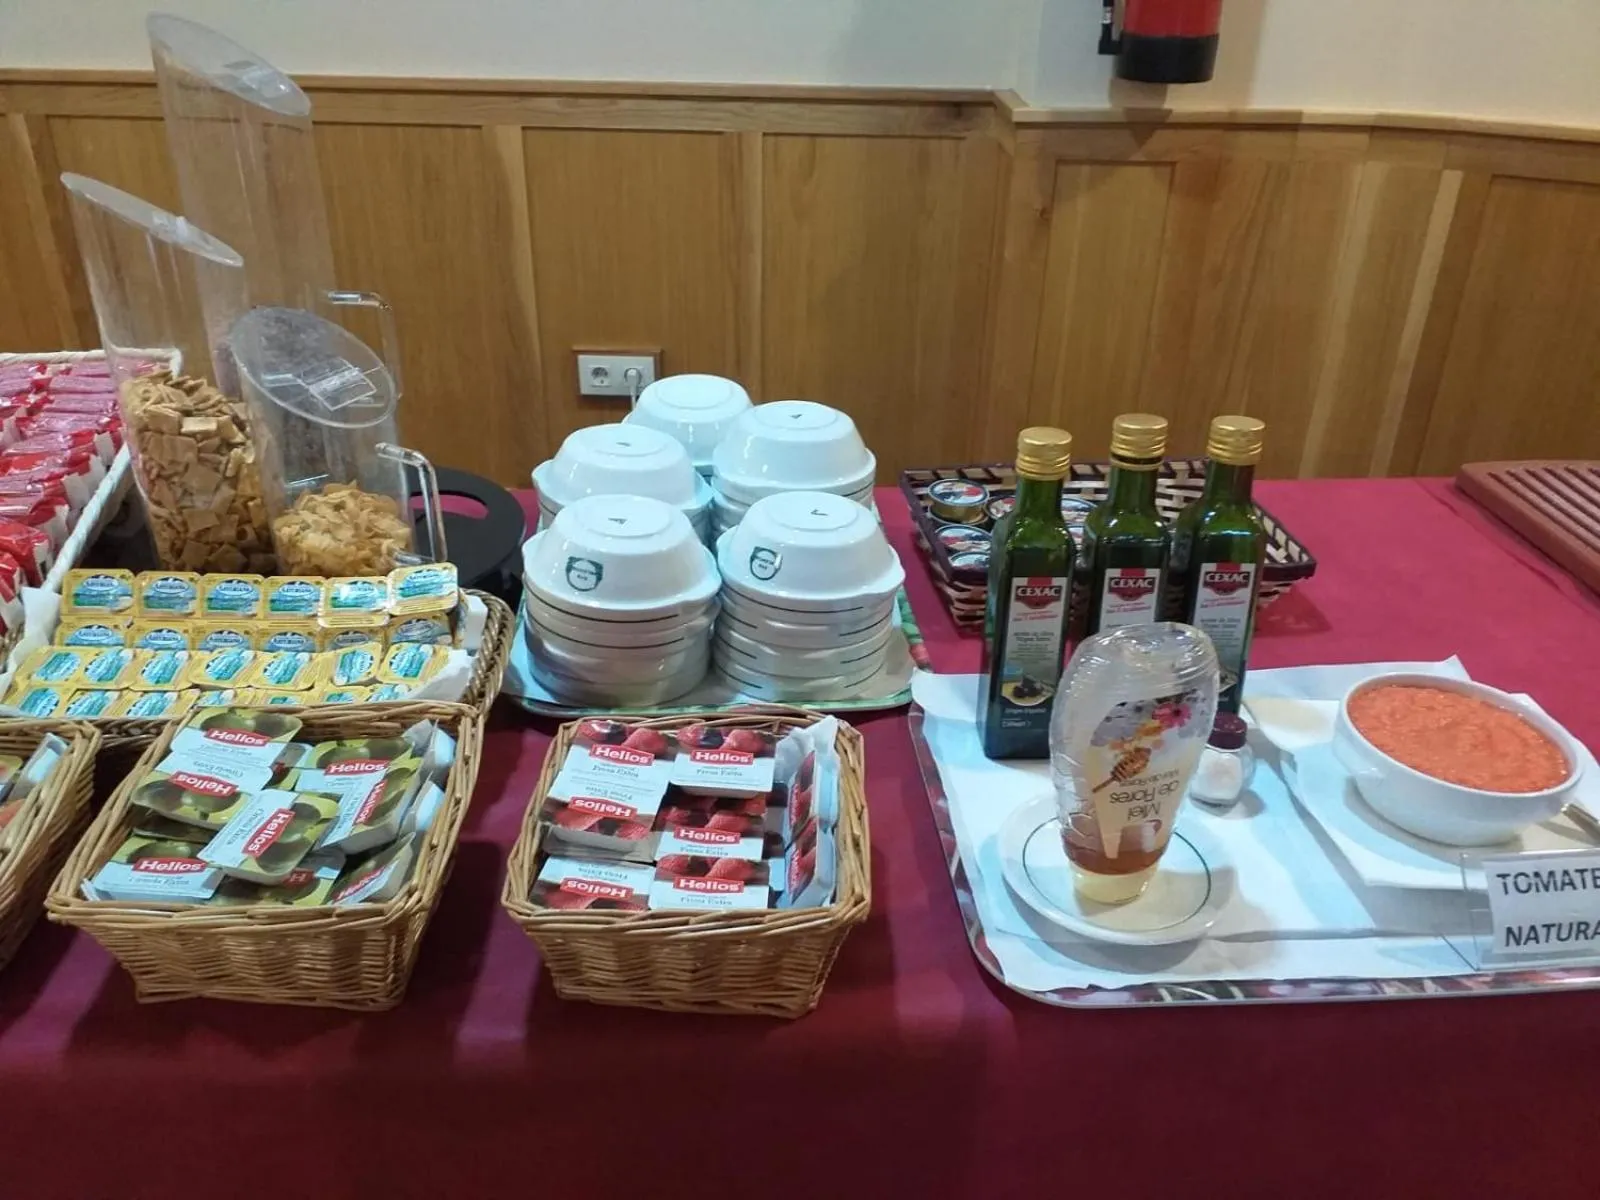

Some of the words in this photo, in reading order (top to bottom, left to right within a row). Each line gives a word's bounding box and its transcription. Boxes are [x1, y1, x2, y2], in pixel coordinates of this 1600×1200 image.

[1110, 578, 1153, 588] CEXAC
[1206, 572, 1249, 583] CEXAC
[1016, 587, 1060, 597] CEXAC
[209, 730, 265, 746] Helios
[593, 746, 651, 764] Helios
[695, 751, 751, 763] Helios
[329, 762, 386, 774] Helios
[176, 773, 233, 794] Helios
[574, 799, 632, 817] Helios
[1128, 802, 1161, 821] Miel
[246, 812, 291, 855] Helios
[679, 829, 737, 843] Helios
[139, 860, 202, 872] Helios
[679, 879, 741, 892] Helios
[1496, 866, 1600, 896] TOMATE
[566, 881, 628, 898] Helios
